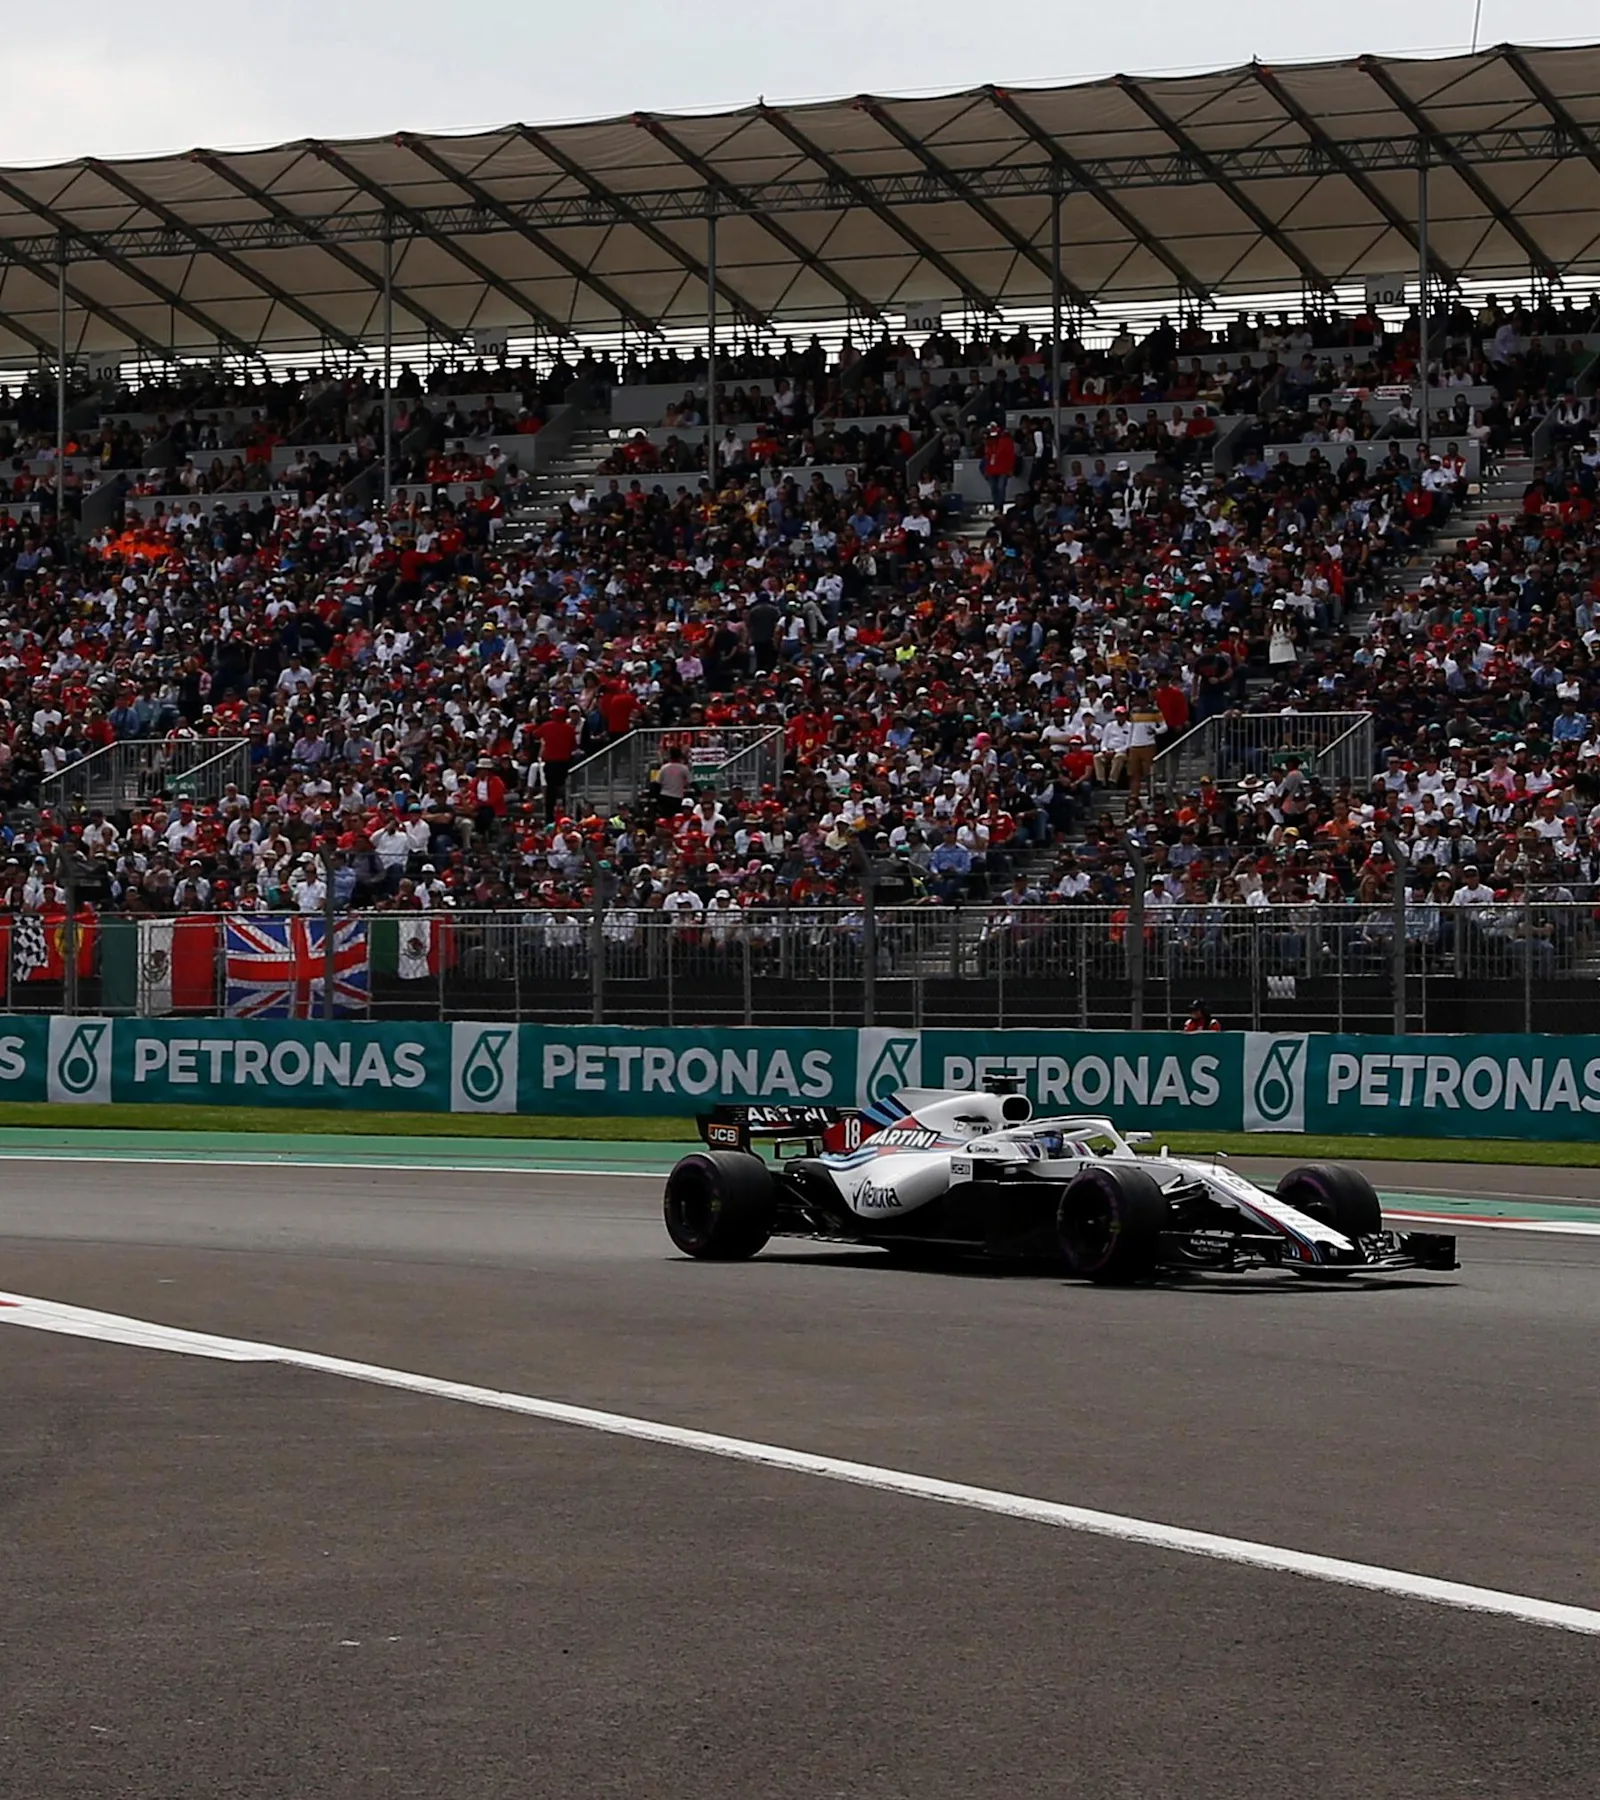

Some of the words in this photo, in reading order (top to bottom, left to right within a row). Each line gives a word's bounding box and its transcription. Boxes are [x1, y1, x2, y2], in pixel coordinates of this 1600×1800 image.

[135, 1038, 426, 1088] PETRONAS
[544, 1045, 833, 1098] PETRONAS
[943, 1055, 1220, 1107] PETRONAS
[710, 1129, 737, 1143] JCB
[844, 1118, 861, 1149] 18
[864, 1127, 941, 1149] MARTINI
